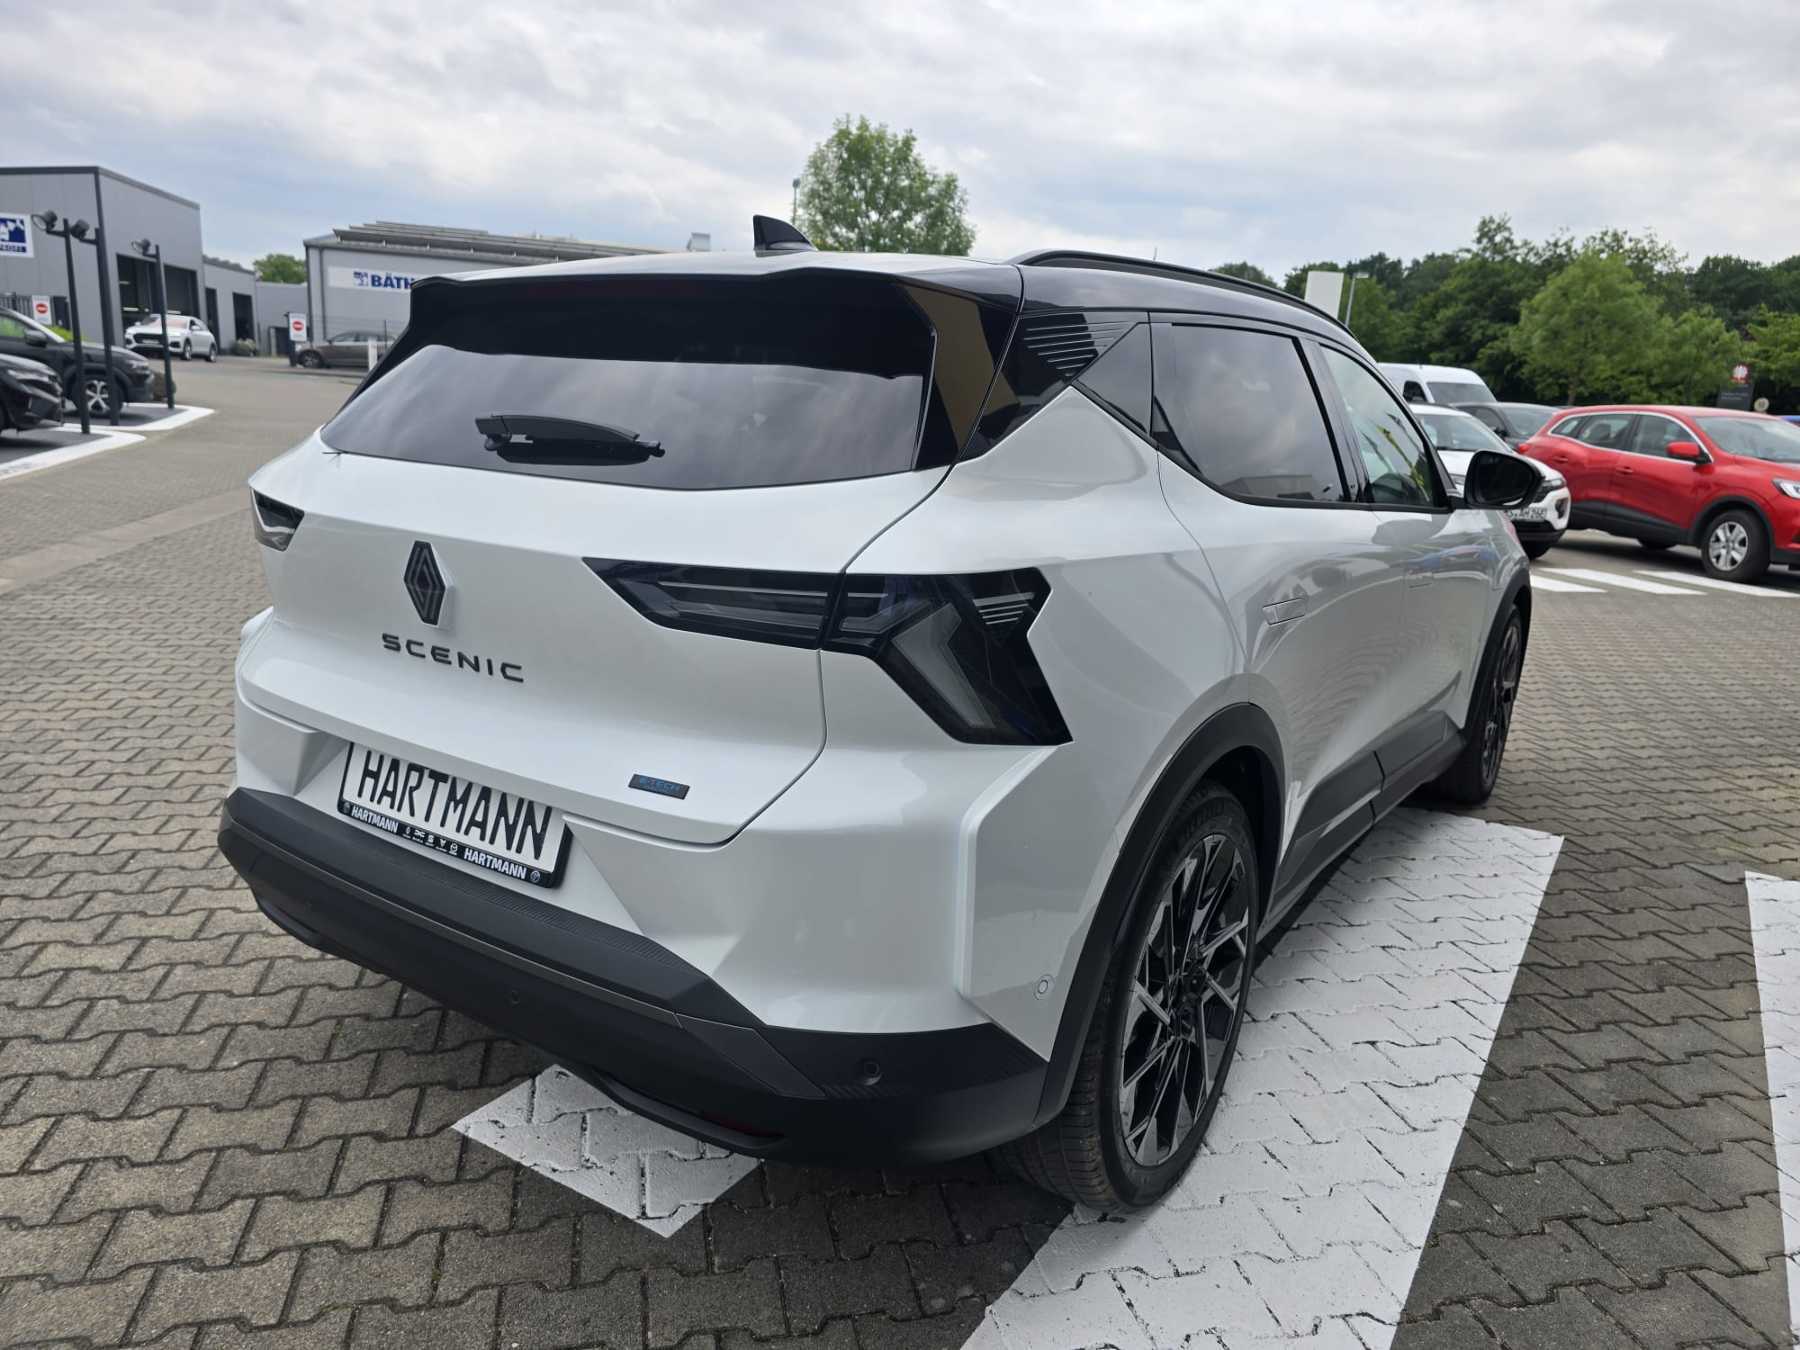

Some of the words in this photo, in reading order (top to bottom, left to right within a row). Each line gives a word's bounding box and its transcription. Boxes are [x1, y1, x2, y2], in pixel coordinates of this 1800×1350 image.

[382, 633, 524, 683] SCENIC
[351, 806, 399, 834] HARTMANN
[357, 750, 553, 860] HARTMANN
[463, 848, 527, 880] HARTMANN
